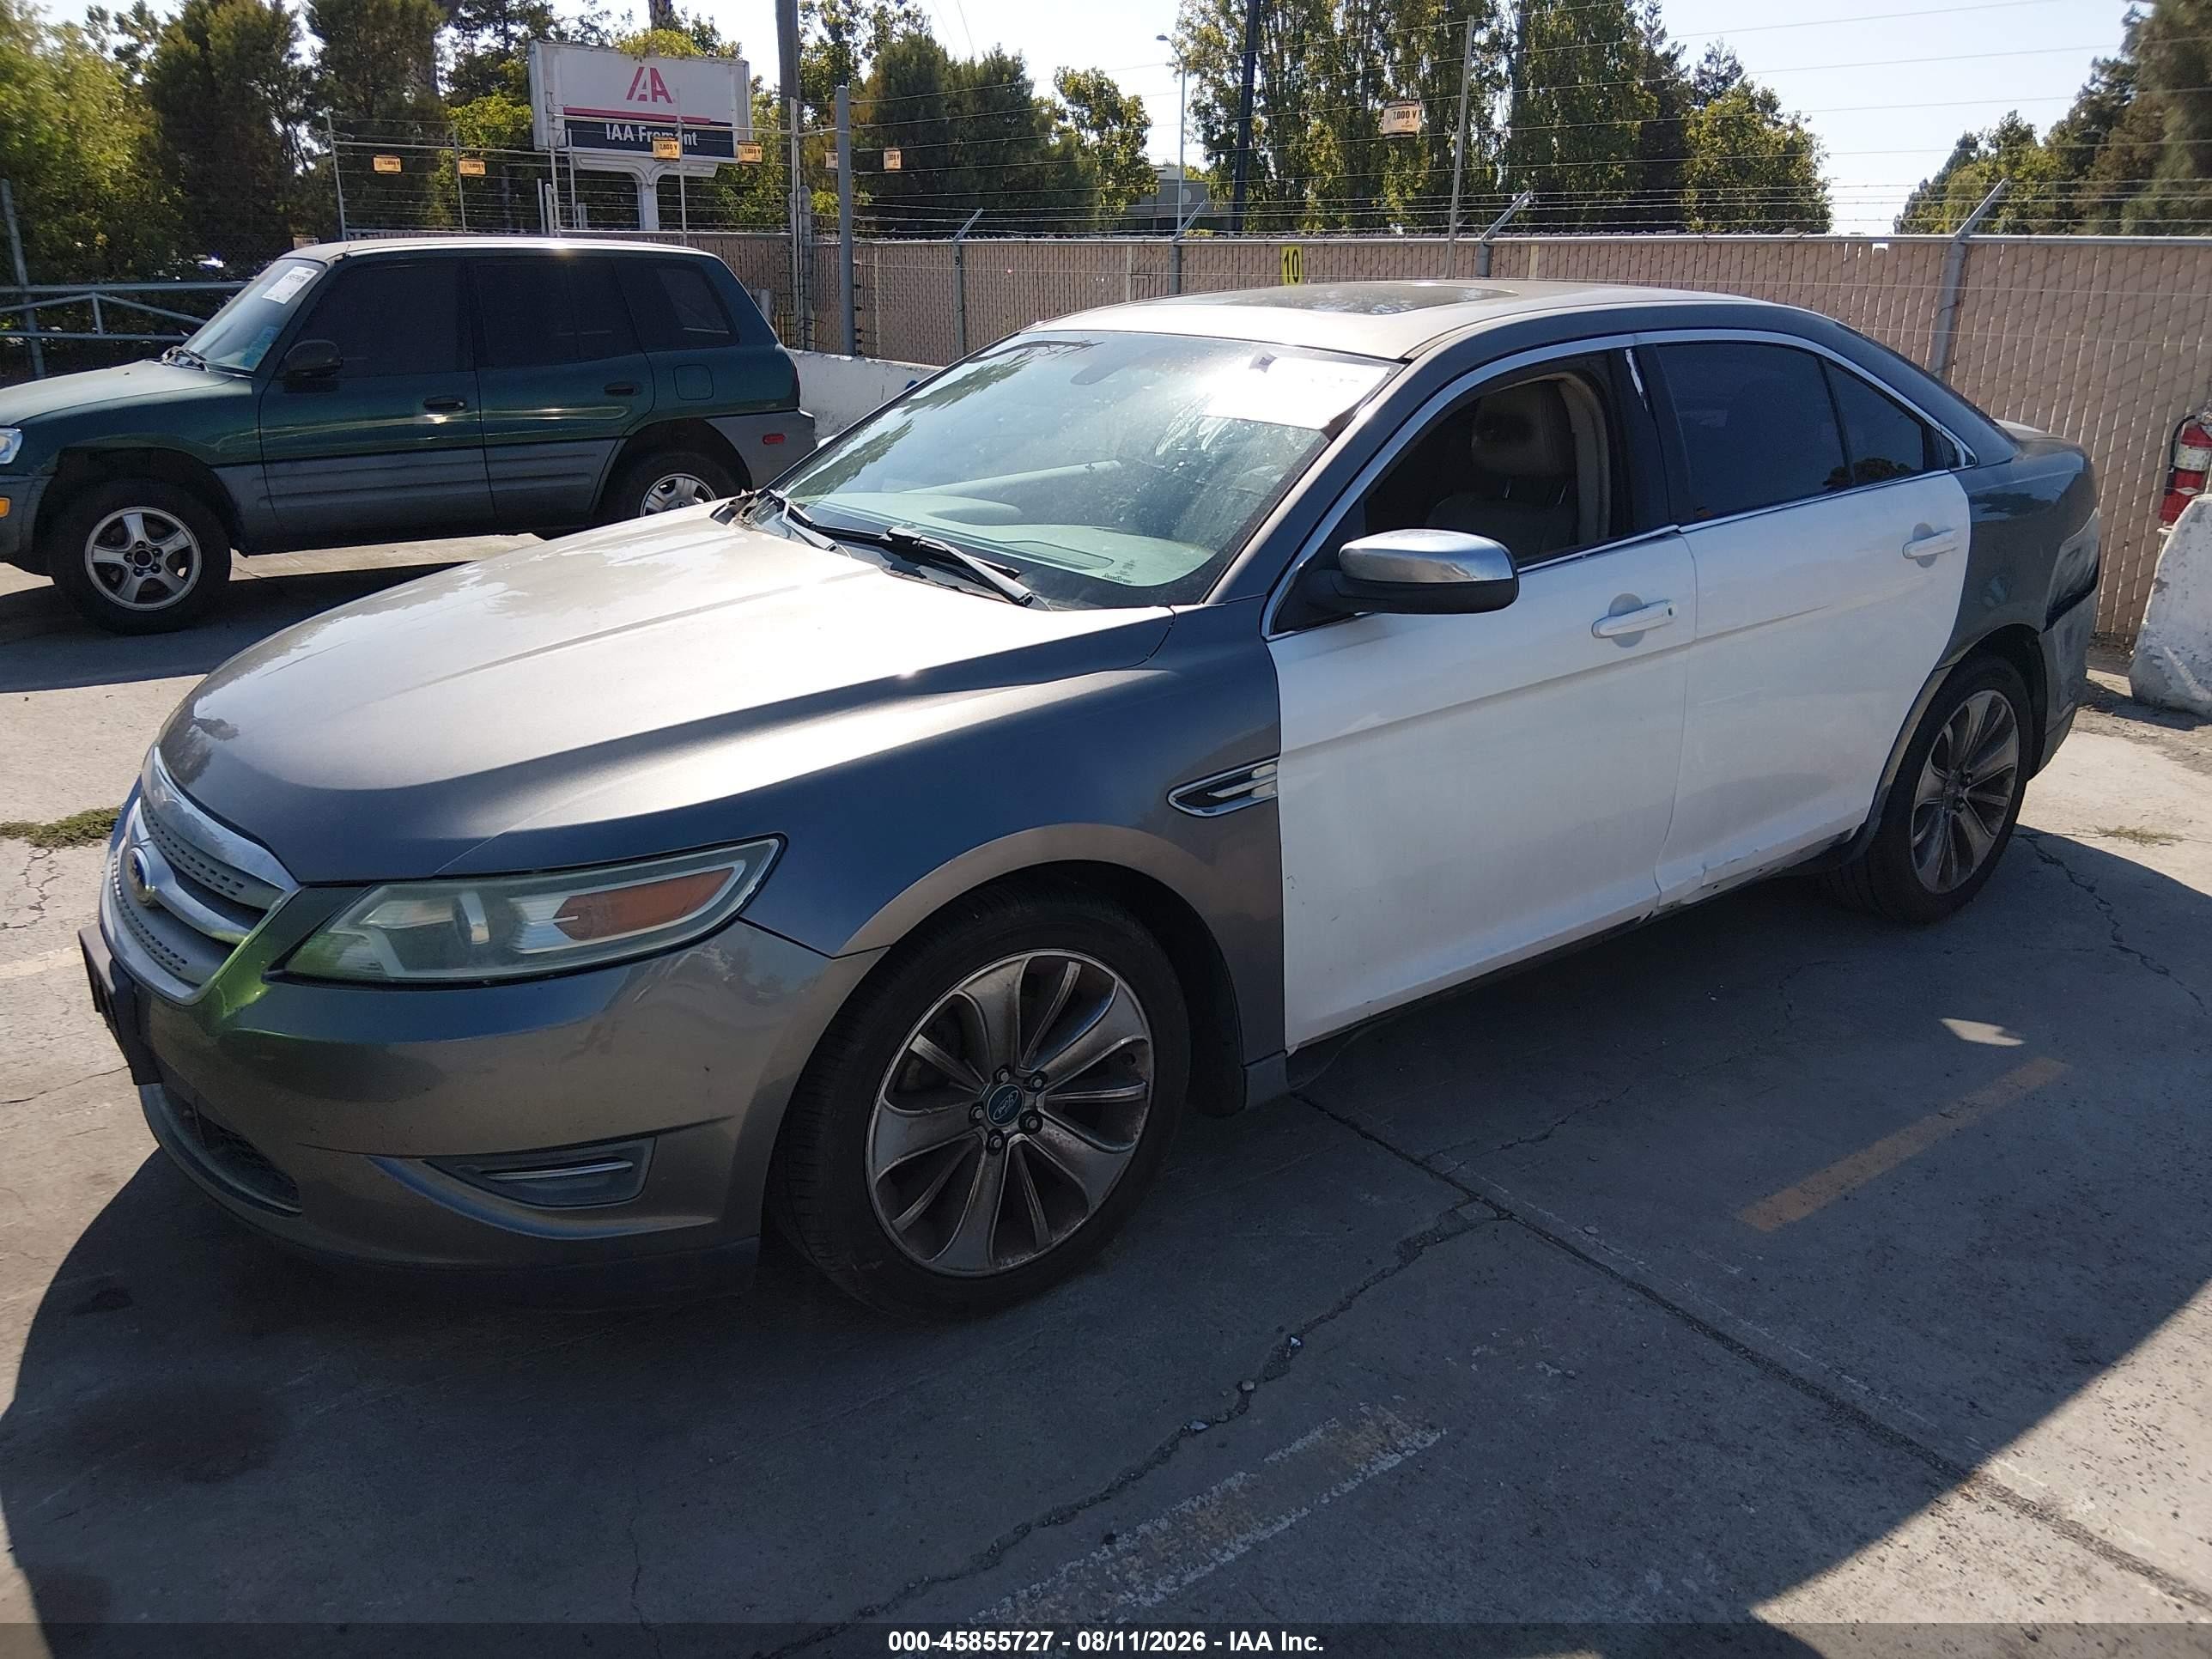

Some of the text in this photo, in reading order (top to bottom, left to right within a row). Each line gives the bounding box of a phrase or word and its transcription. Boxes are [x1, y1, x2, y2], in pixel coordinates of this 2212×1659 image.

[1393, 110, 1417, 120] 7,000 V
[605, 123, 635, 143] IAA
[955, 256, 960, 265] 9
[1284, 249, 1299, 283] 10
